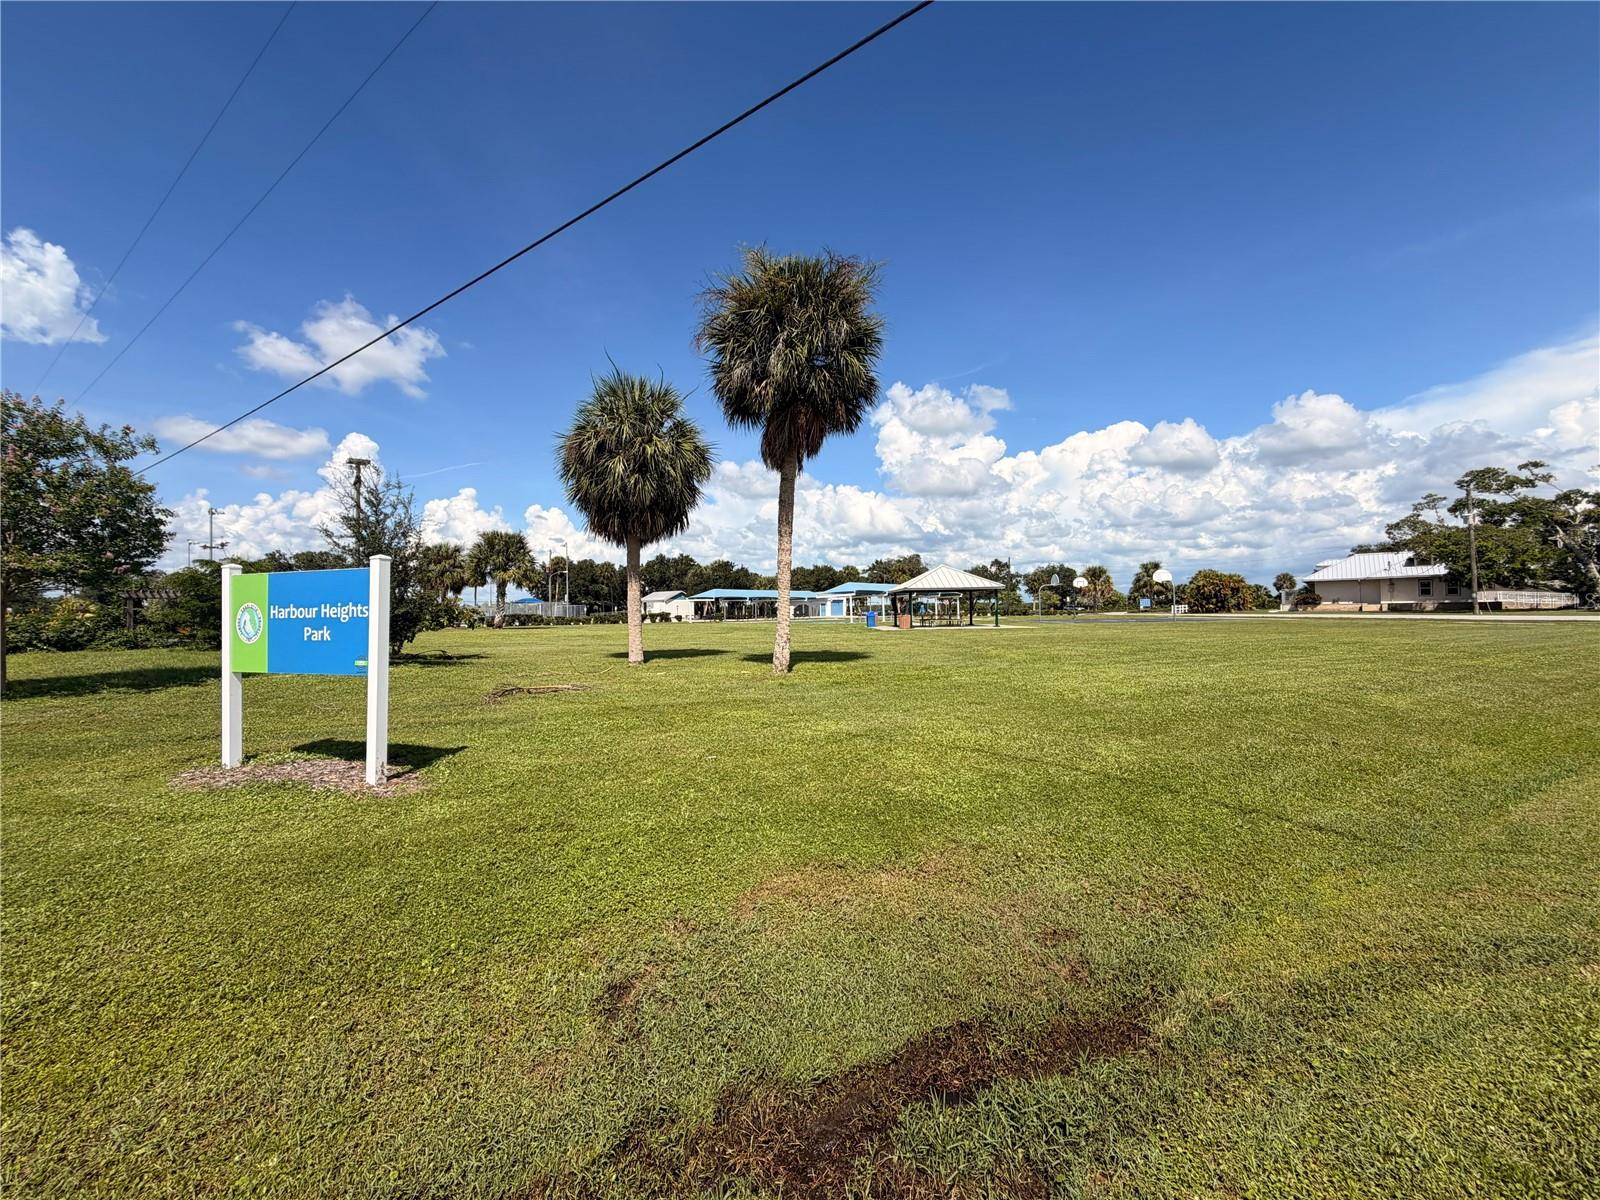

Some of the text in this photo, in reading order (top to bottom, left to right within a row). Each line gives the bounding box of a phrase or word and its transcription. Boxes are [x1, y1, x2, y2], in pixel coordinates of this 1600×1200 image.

[270, 602, 369, 622] Harbour Heights
[304, 625, 331, 641] Park
